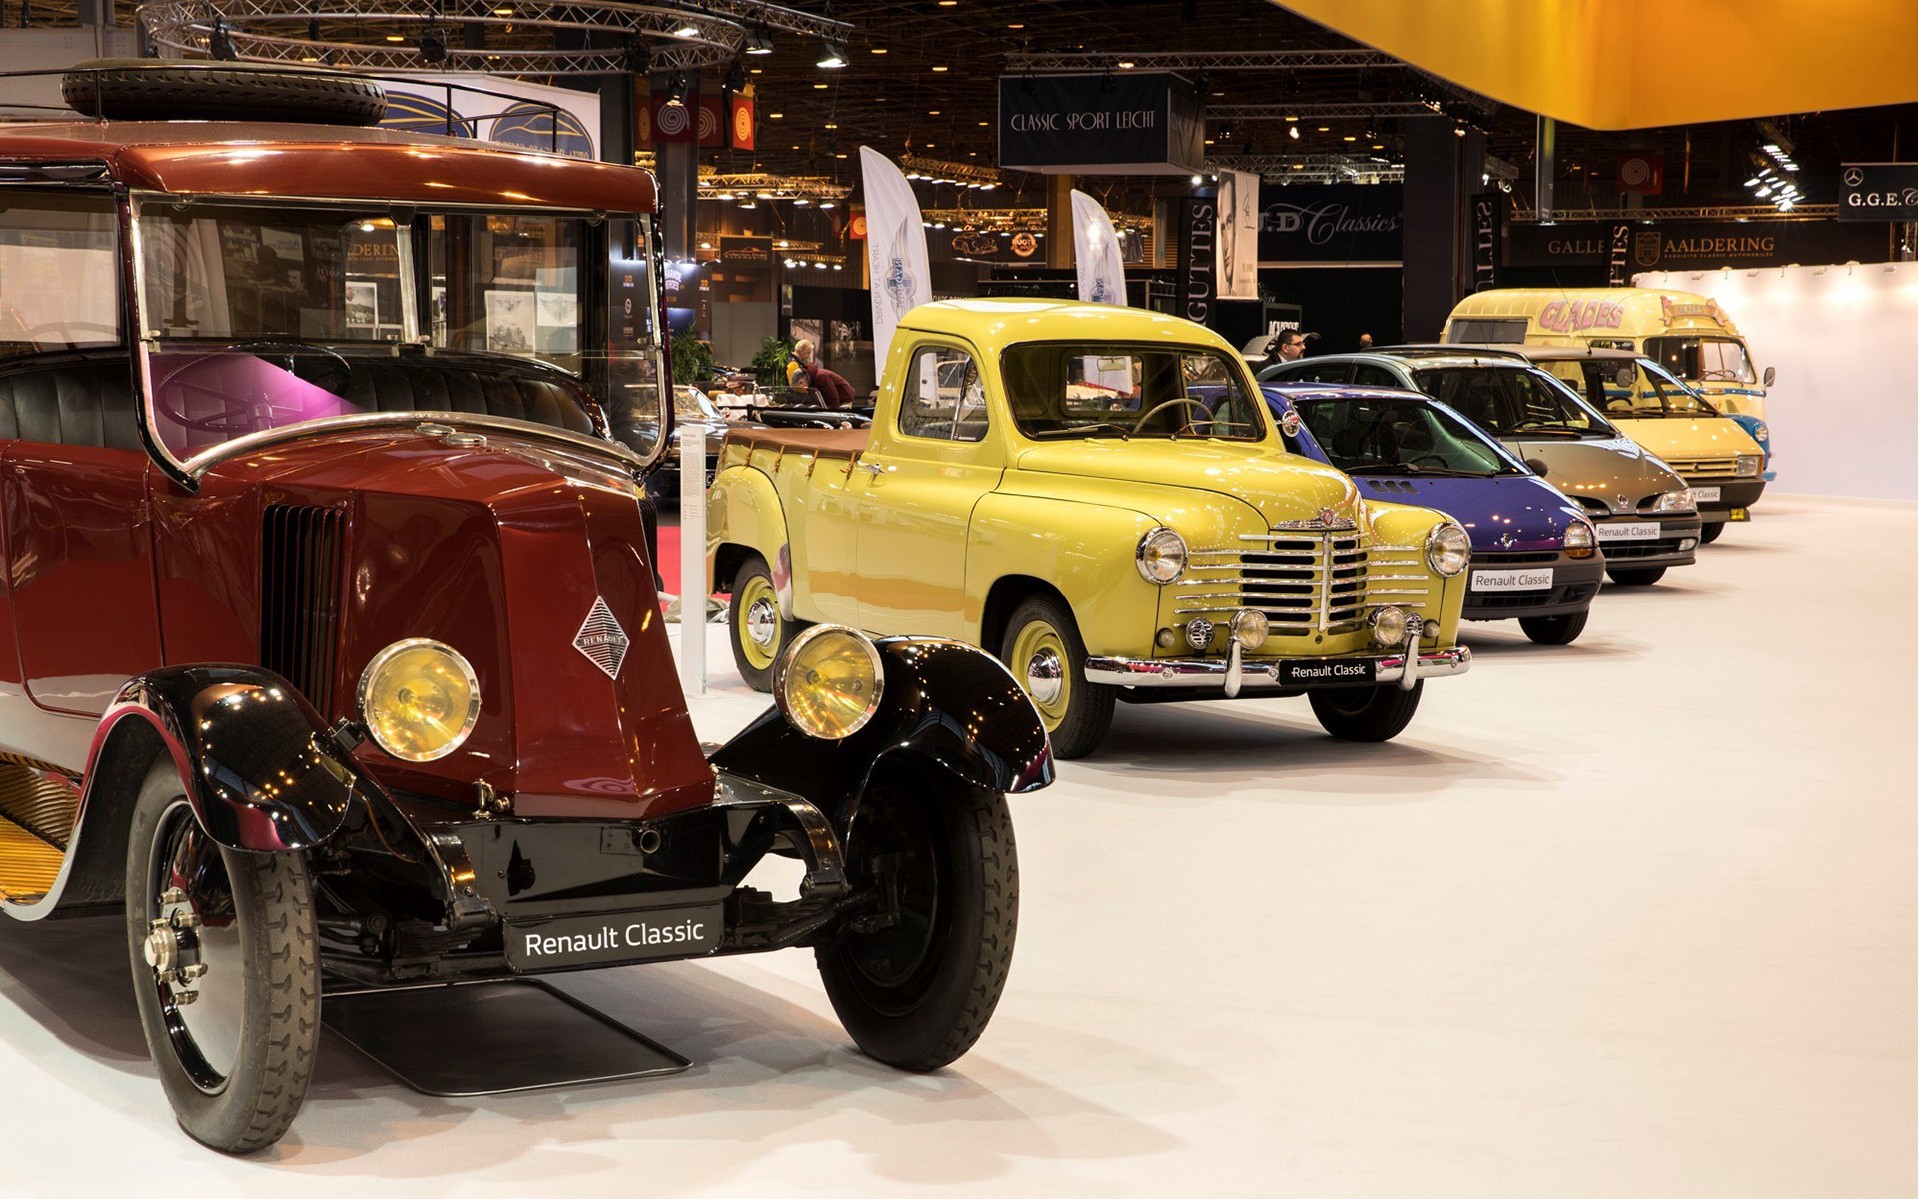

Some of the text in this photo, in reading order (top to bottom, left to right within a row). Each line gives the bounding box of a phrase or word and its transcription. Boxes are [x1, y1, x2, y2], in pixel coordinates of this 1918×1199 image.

[1010, 112, 1061, 132] CLASSIC
[1066, 111, 1111, 130] SPORT
[1116, 110, 1156, 129] LEICHT
[1847, 192, 1902, 207] G.G.E.
[1300, 202, 1401, 246] Classics
[1663, 237, 1775, 252] AALDERING
[1186, 204, 1213, 326] GUTTES
[1539, 299, 1625, 334] GLACES
[1598, 526, 1658, 537] Renault Classic
[1475, 573, 1550, 587] Renault Classic
[1292, 663, 1367, 678] Renault Classic
[524, 919, 705, 957] Renault Classic
